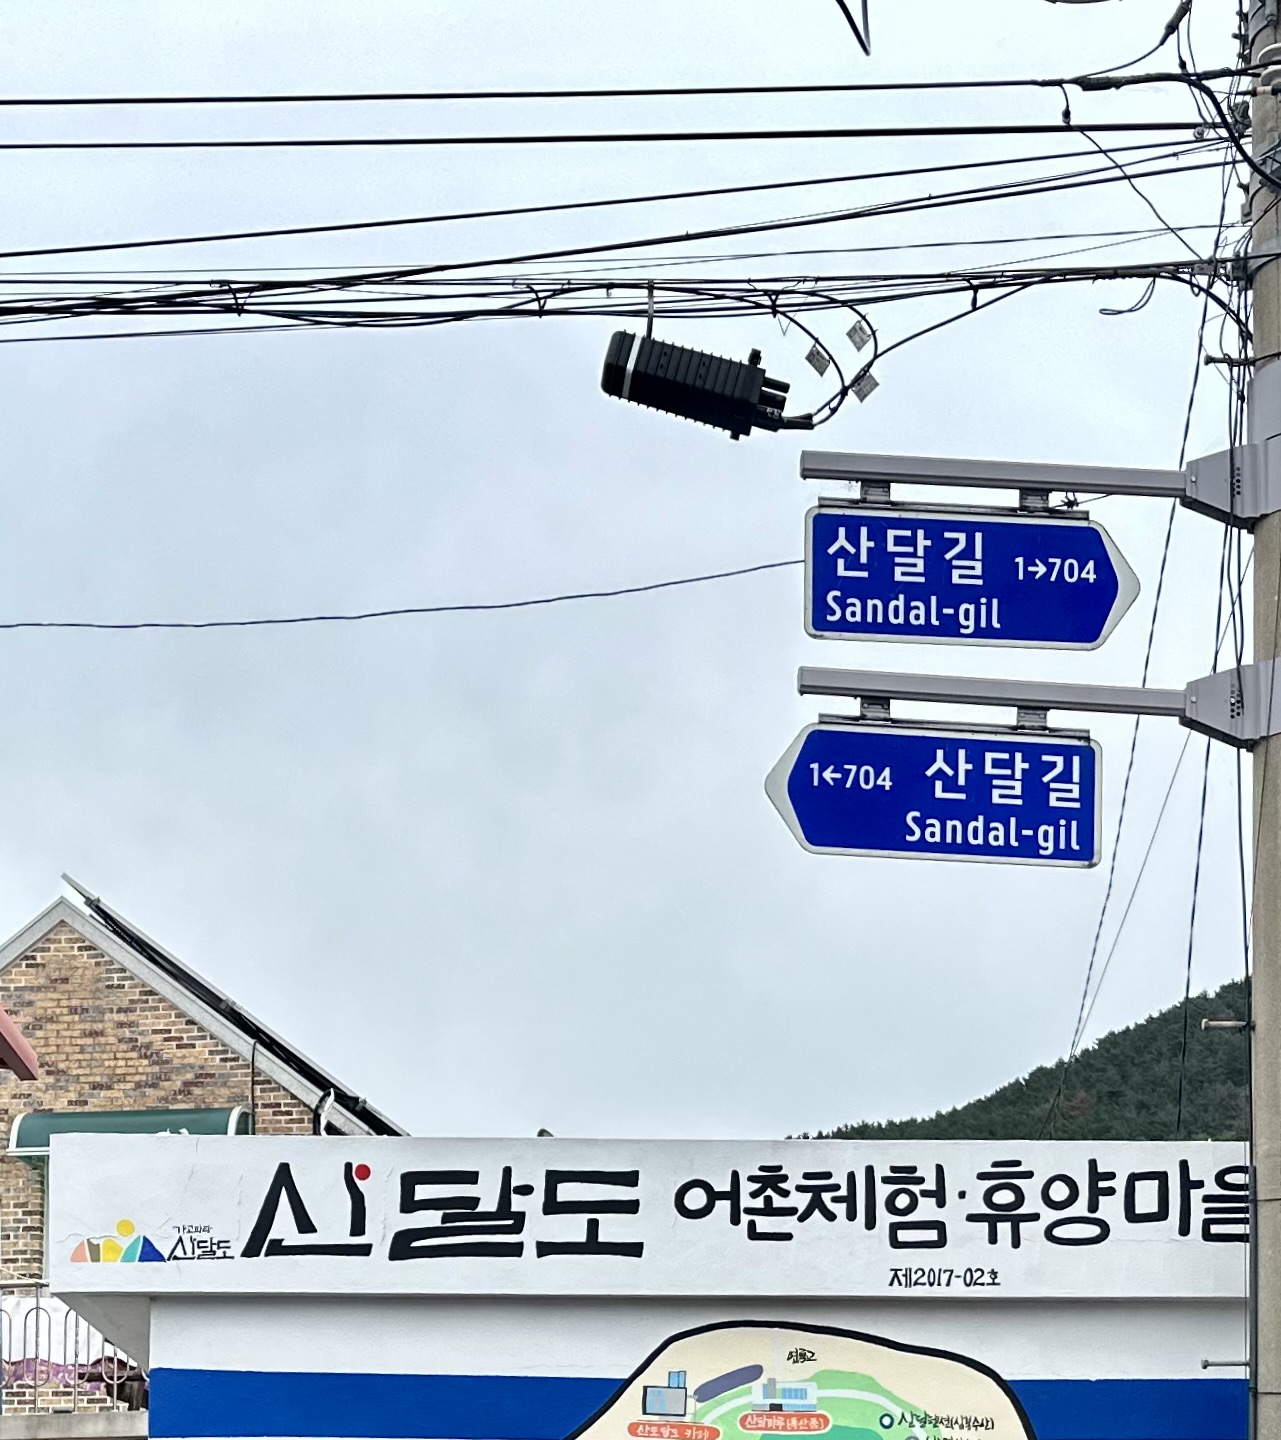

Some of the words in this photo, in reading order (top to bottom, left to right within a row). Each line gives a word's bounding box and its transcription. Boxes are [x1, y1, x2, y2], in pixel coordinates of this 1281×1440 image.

[826, 525, 984, 586] 산달길
[826, 589, 1001, 635] Sandal-gil
[925, 748, 1082, 809] 산달길
[905, 811, 1081, 855] Sandal-gil
[166, 1235, 235, 1261] 산달도
[888, 1267, 1001, 1288] 제2017-02호
